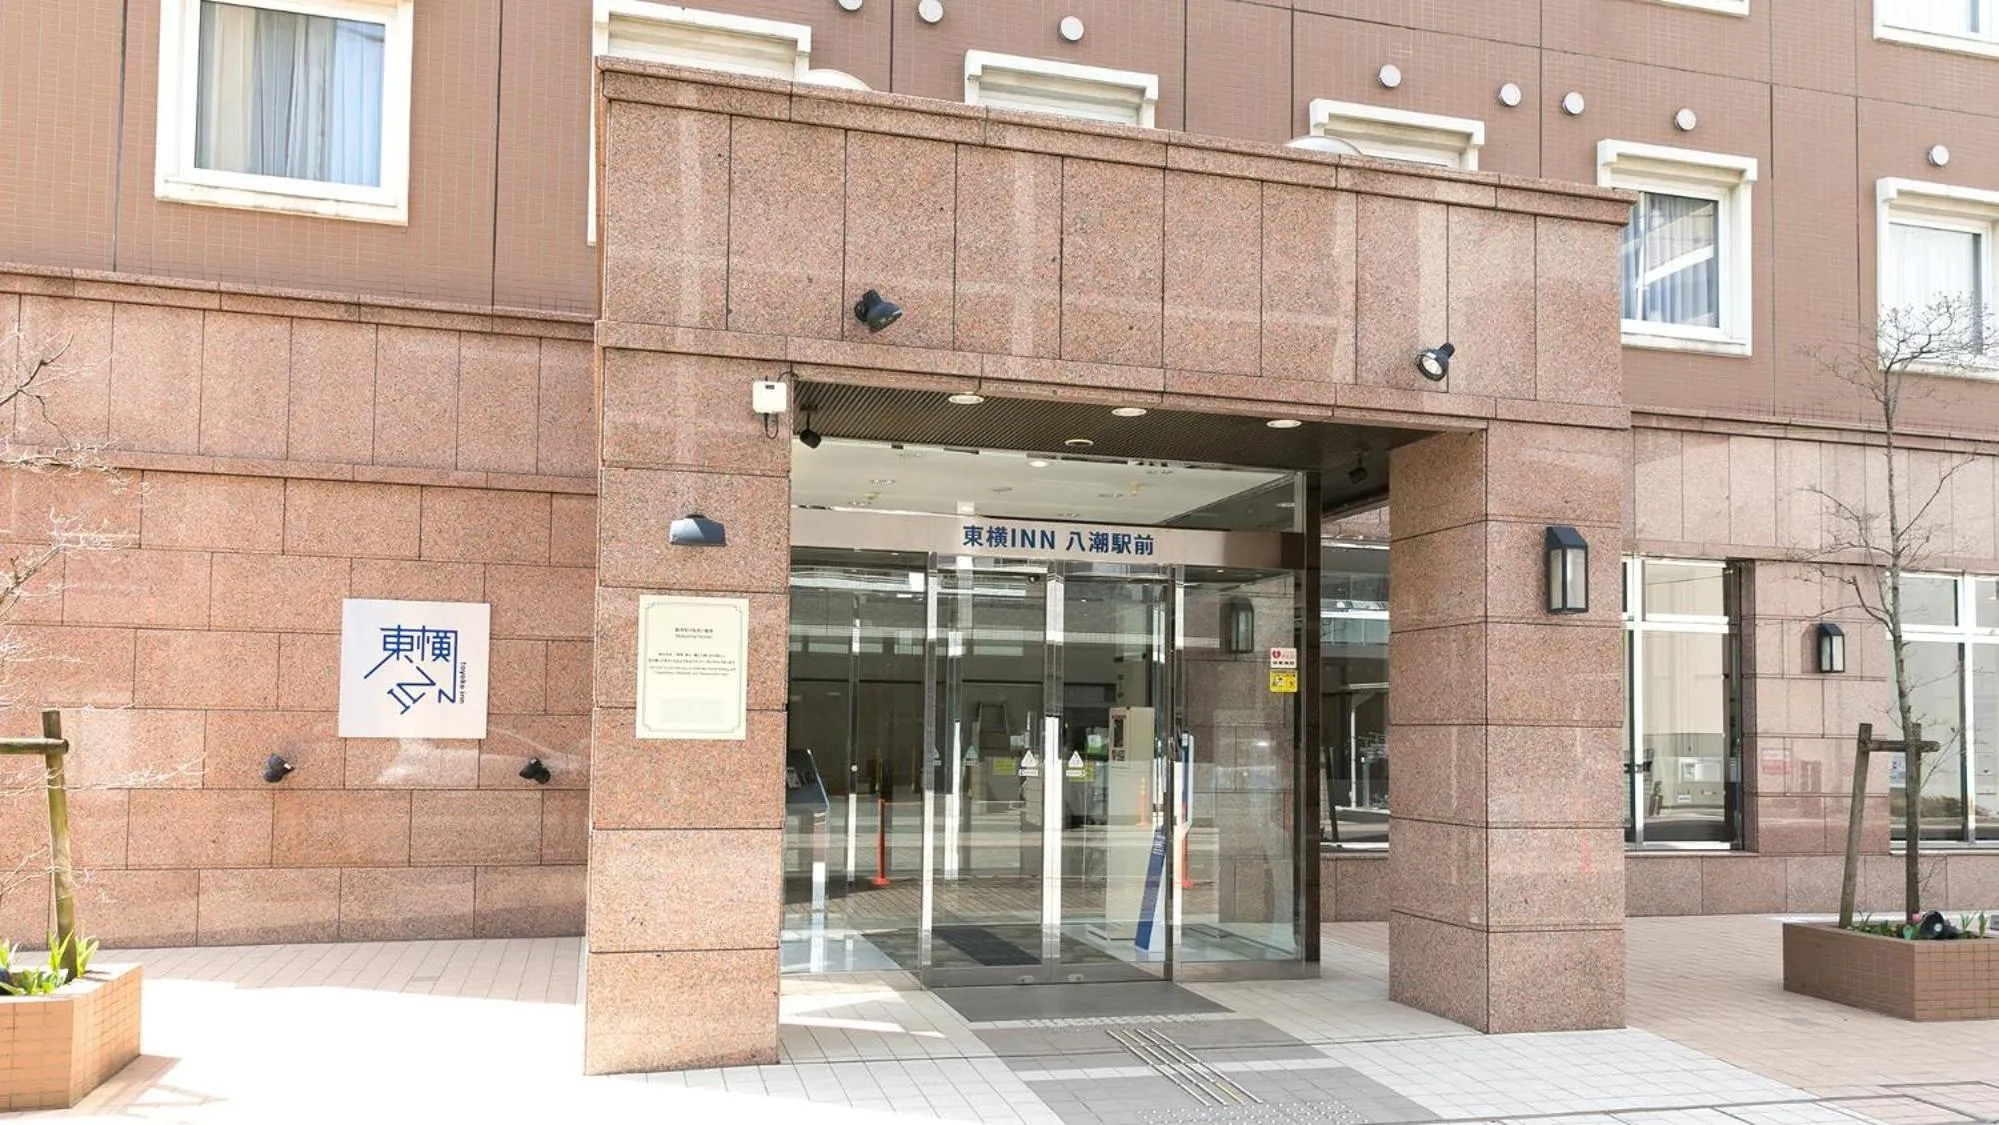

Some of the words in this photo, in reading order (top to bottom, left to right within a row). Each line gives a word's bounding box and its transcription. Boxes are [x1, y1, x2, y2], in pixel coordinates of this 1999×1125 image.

[963, 525, 1056, 550] 東横INN
[1066, 531, 1155, 556] 八潮駅前
[459, 662, 467, 689] toyoko
